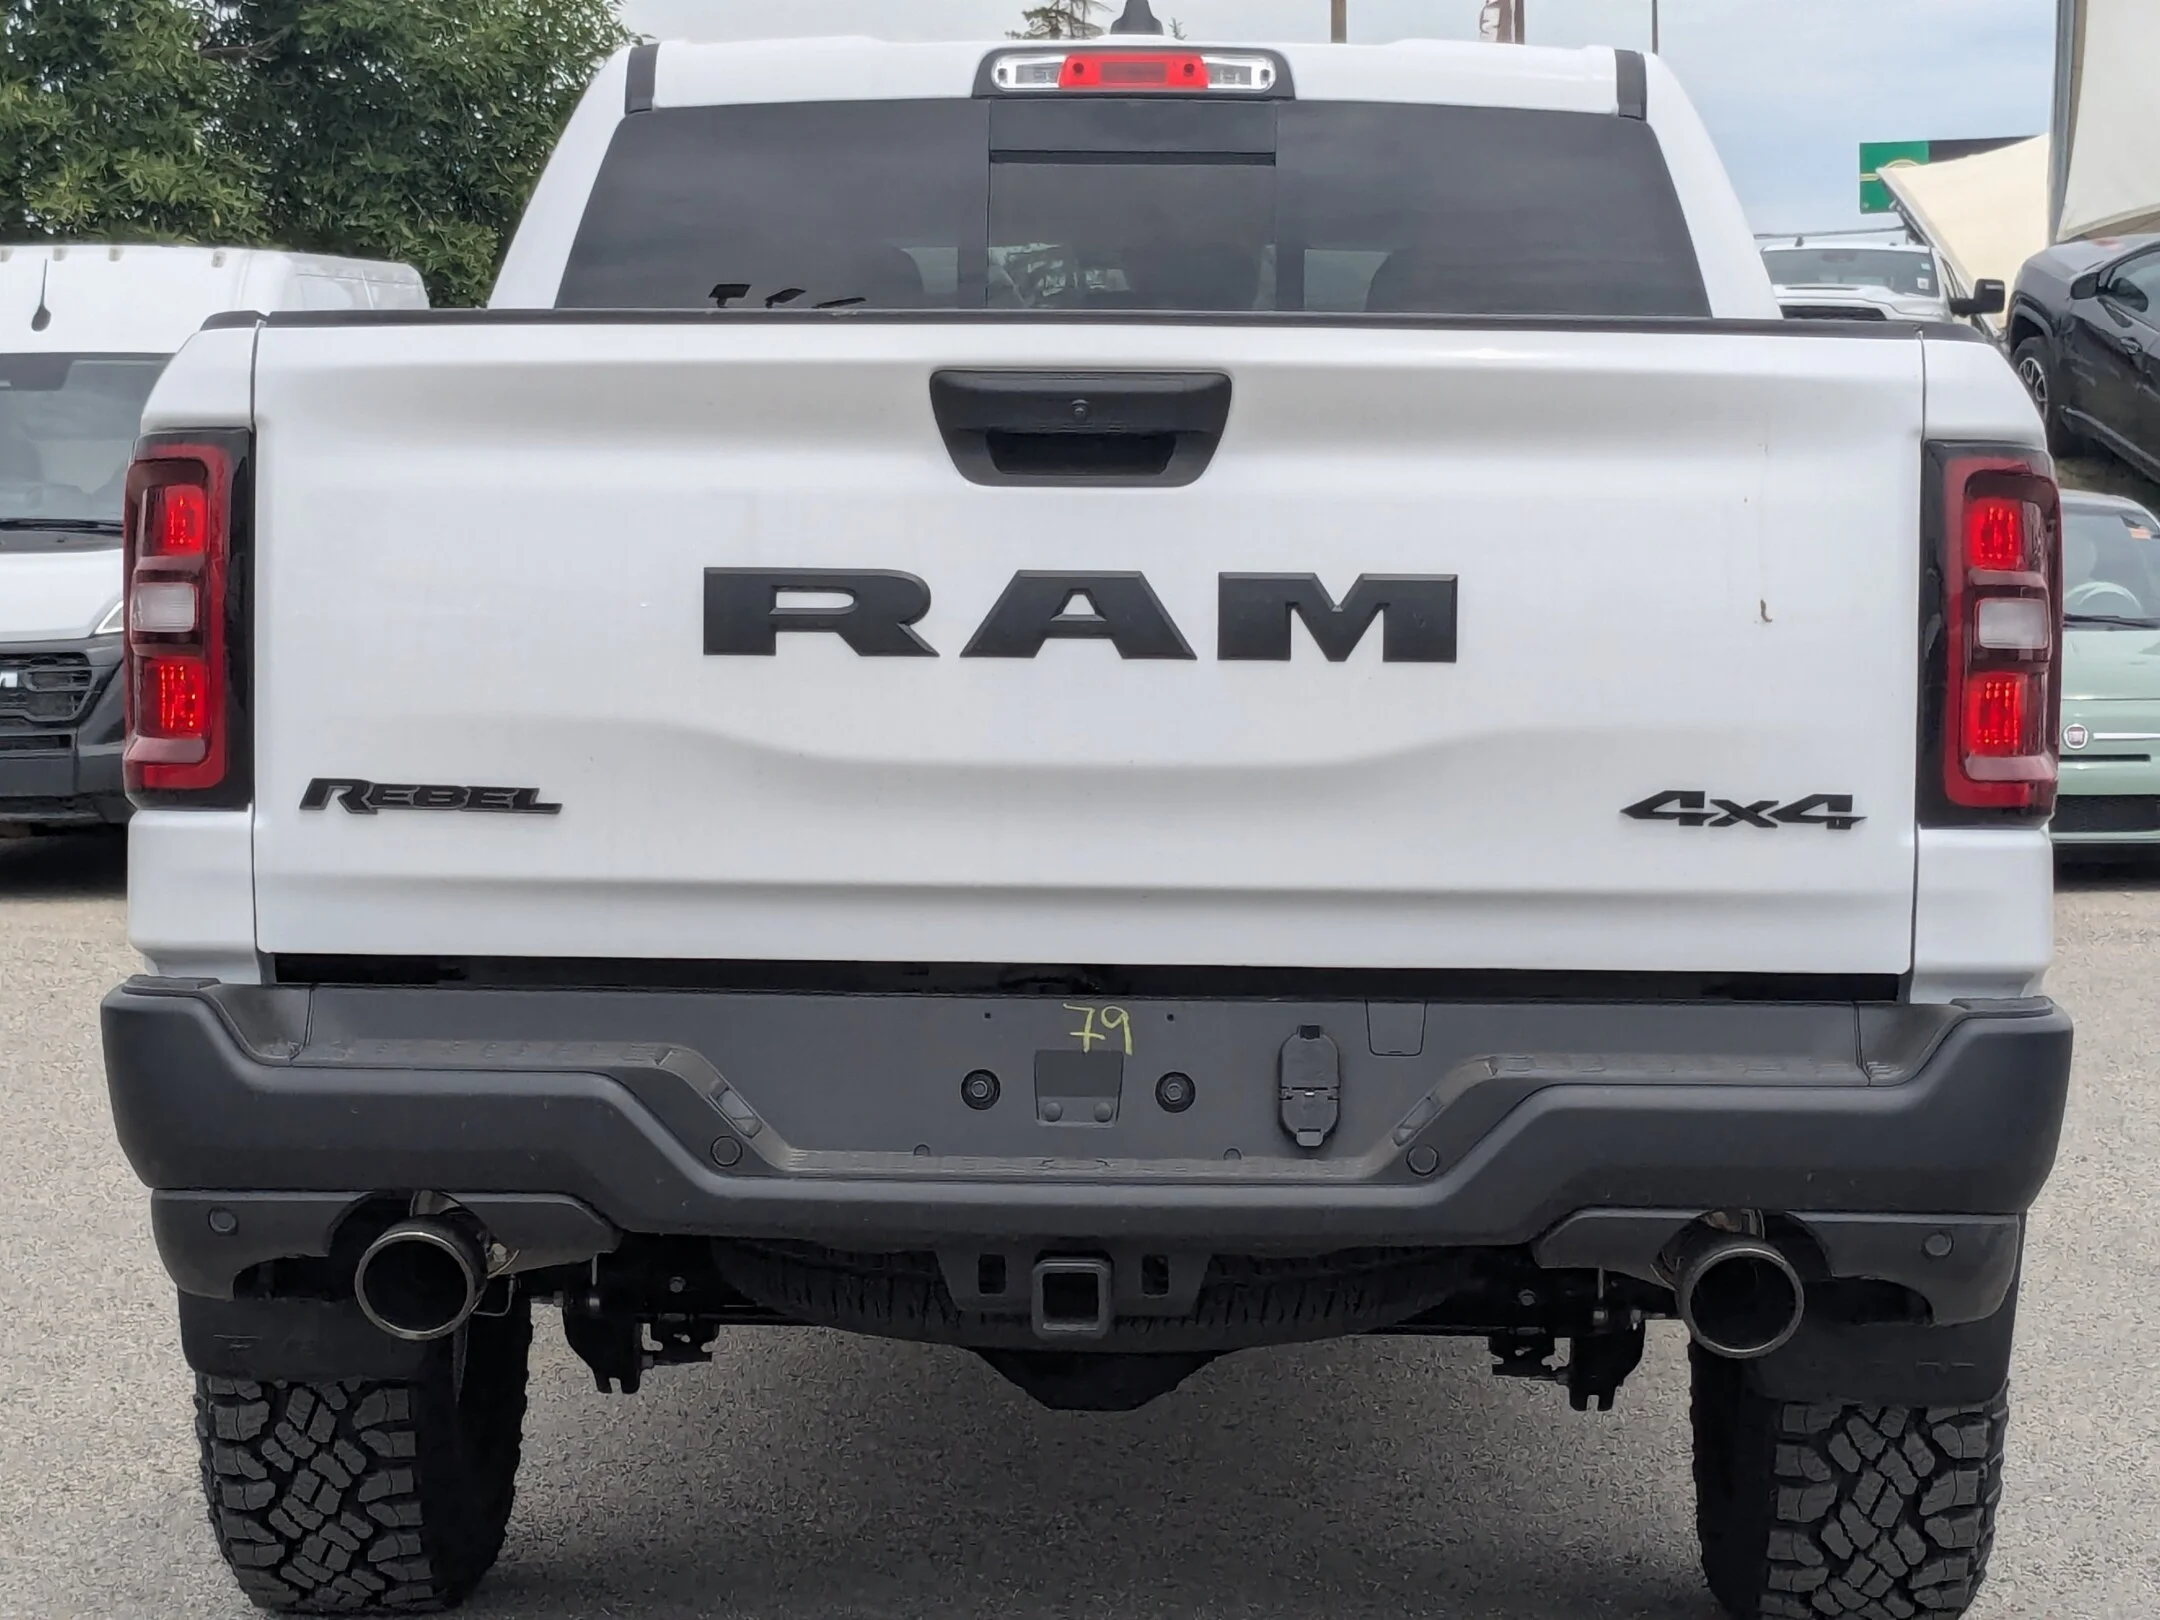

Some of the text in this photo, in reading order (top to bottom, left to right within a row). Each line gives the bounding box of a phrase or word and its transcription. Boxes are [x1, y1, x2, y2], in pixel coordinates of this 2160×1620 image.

[703, 567, 1458, 662] RAM
[299, 778, 562, 815] REBEL
[1619, 790, 1868, 830] 4x4
[1062, 1003, 1133, 1056] 79
